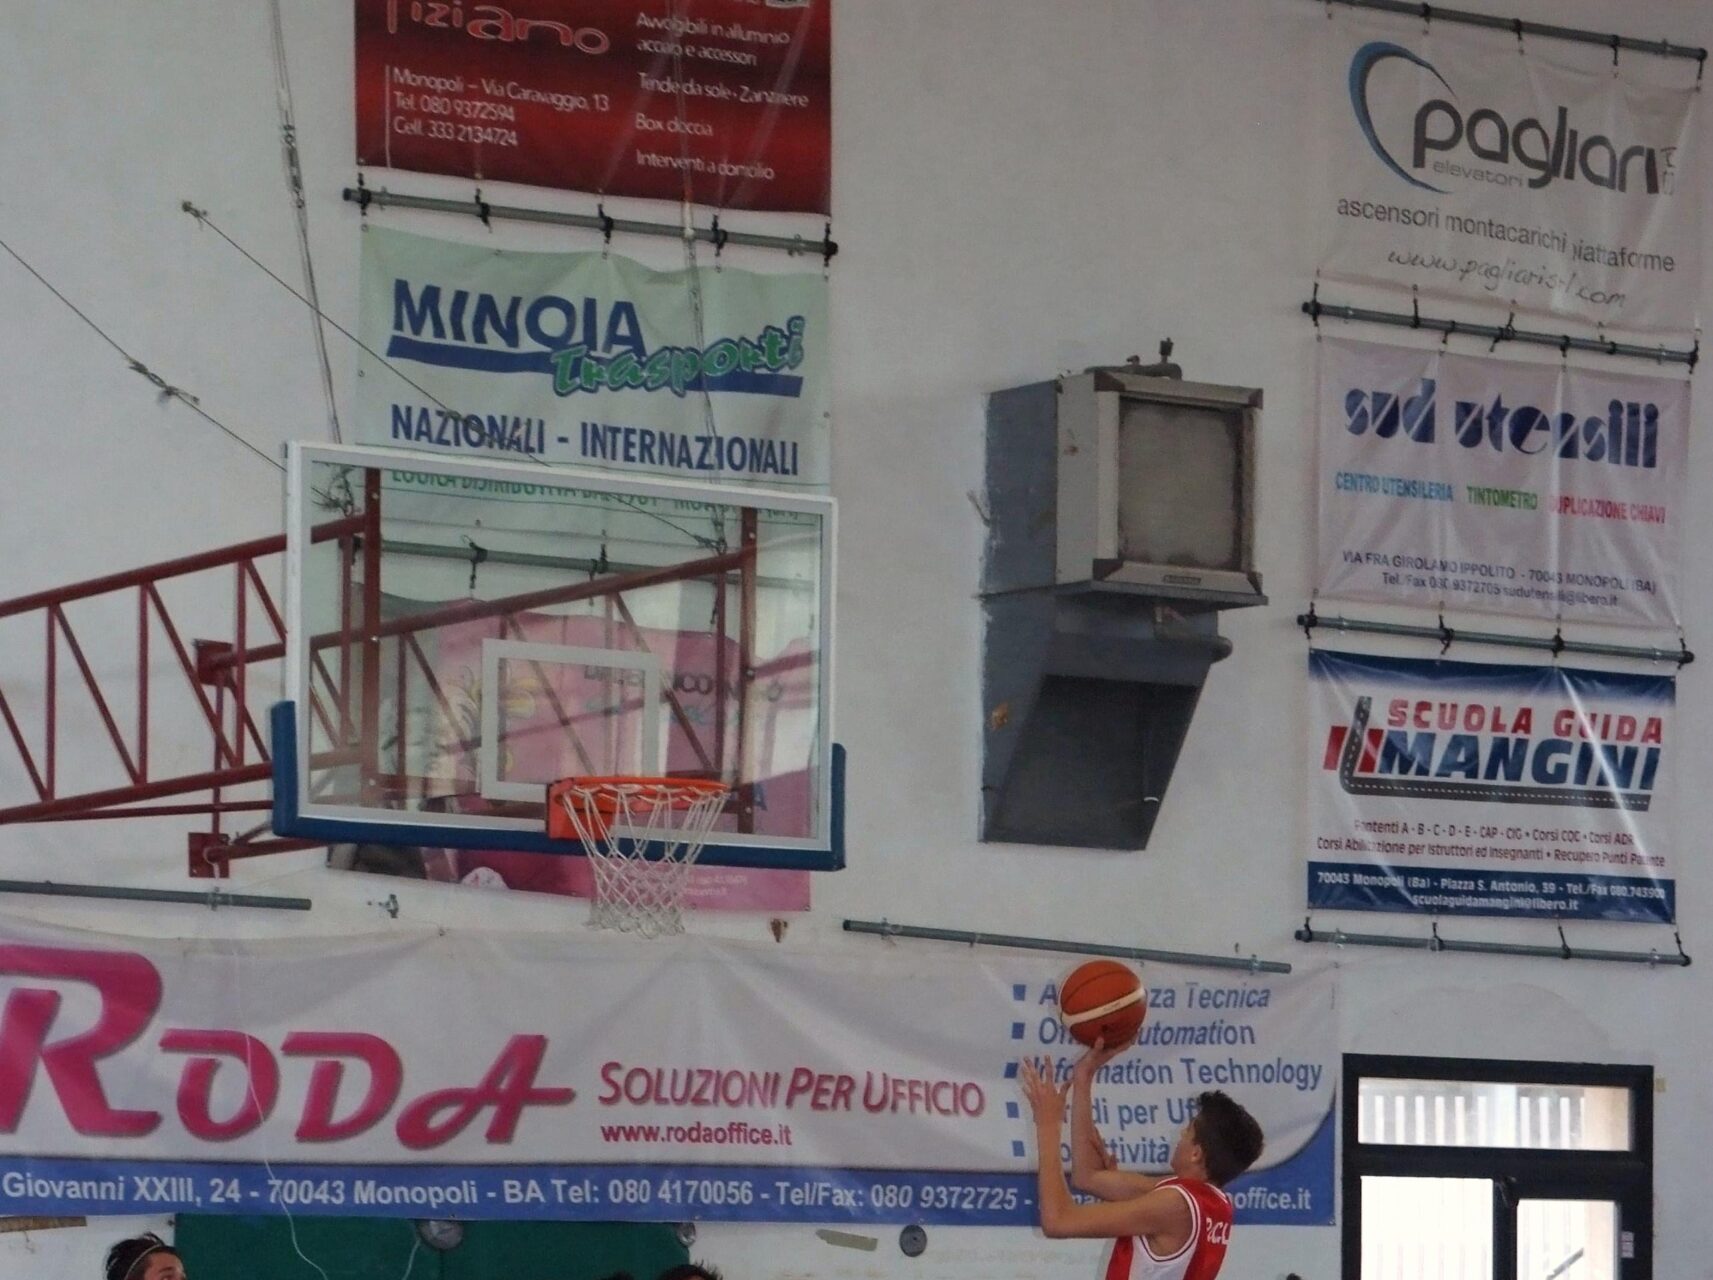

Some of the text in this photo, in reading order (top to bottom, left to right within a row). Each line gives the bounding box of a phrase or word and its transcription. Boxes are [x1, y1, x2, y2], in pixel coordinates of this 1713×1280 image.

[393, 67, 464, 94] Monopoli
[481, 78, 504, 96] Via
[594, 93, 610, 112] 13
[420, 95, 450, 115] 080
[427, 120, 454, 140] 333
[636, 112, 664, 131] Box
[1433, 158, 1525, 188] elevatori
[1337, 197, 1440, 230] ascensori
[1445, 213, 1567, 251] montacarichi
[392, 278, 647, 355] MINOIA
[550, 314, 806, 397] Trasporti
[391, 403, 545, 454] NAZIONALI
[581, 421, 799, 476] INTERNAZIONALI
[1344, 377, 1659, 468] sud utensili
[1335, 472, 1380, 494] CENTRO
[1382, 476, 1454, 501] UTENSILERIA
[1466, 486, 1538, 511] TINTOMETRO
[1343, 551, 1363, 564] VIA
[1365, 552, 1390, 567] FRA
[1460, 562, 1516, 580] IPPOLITO
[1566, 573, 1630, 591] MONOPOL
[1387, 698, 1664, 744] SCUOLA GUIDA
[1377, 729, 1661, 791] MANGINI
[1417, 823, 1425, 836] B
[1433, 823, 1441, 836] C
[1448, 824, 1456, 837] D
[1479, 825, 1497, 839] CAP
[1533, 828, 1558, 842] Corsi
[1317, 836, 1343, 851] Corsi
[1408, 843, 1426, 857] per
[1554, 849, 1600, 865] Recupero
[1317, 871, 1350, 885] 70043
[1353, 873, 1404, 889] Monopoli
[1407, 876, 1430, 890] (Ba)
[1440, 878, 1475, 891] Piazza
[1186, 981, 1271, 1009] Tecnica
[1135, 1019, 1256, 1047] utomation
[1180, 1056, 1322, 1090] Technology
[601, 1121, 793, 1147] www.rodaoffice.it
[1119, 1103, 1158, 1131] per
[2, 1171, 125, 1201] Giovanni
[132, 1175, 202, 1207] XXIII,
[209, 1177, 242, 1203] 24
[267, 1179, 346, 1205] 70043
[353, 1179, 480, 1209] Monopoli
[503, 1181, 542, 1205] BA
[551, 1180, 599, 1205] Tel:
[609, 1180, 650, 1204] 080
[657, 1181, 753, 1206] 4170056
[775, 1181, 864, 1207] Tel/Fax:
[871, 1185, 912, 1209] 080
[919, 1185, 1017, 1210] 9372725
